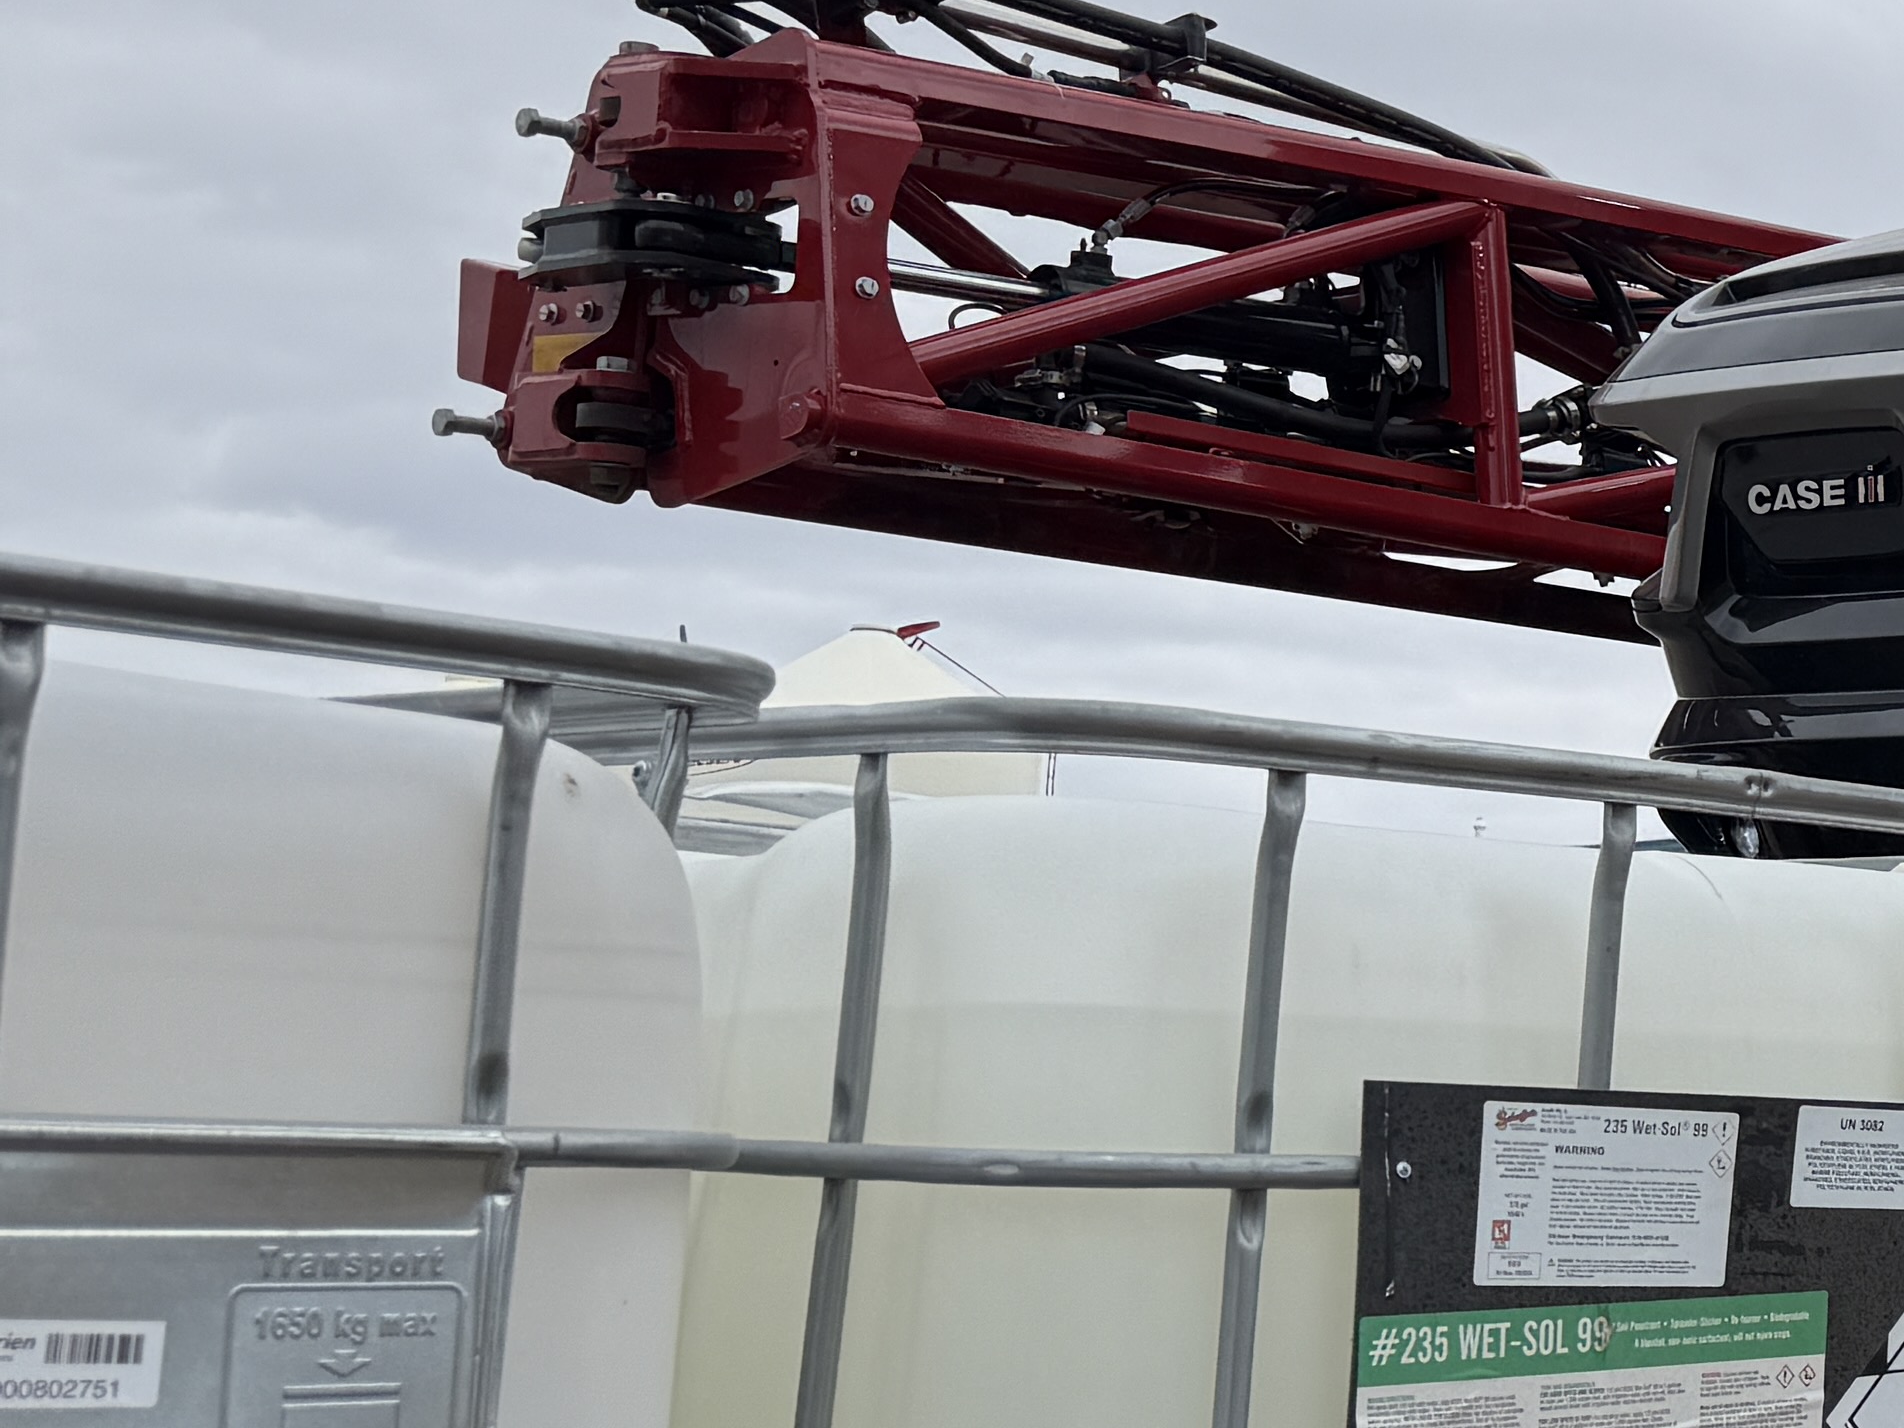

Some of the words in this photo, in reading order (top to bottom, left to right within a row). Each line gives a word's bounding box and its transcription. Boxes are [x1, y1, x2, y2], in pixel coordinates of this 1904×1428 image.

[1747, 479, 1845, 515] CASE
[1603, 1118, 1628, 1134] 235
[1692, 1122, 1709, 1137] 99
[1840, 1118, 1856, 1131] UN
[1554, 1145, 1605, 1156] WARNING
[257, 1245, 446, 1282] Transport
[254, 1305, 323, 1341] 1650
[333, 1305, 368, 1345] kg
[378, 1311, 439, 1338] max
[1369, 1325, 1449, 1367] #235
[1458, 1317, 1569, 1362] WET-SOL
[1577, 1315, 1611, 1354] 99
[0, 1378, 120, 1400] 00802751
